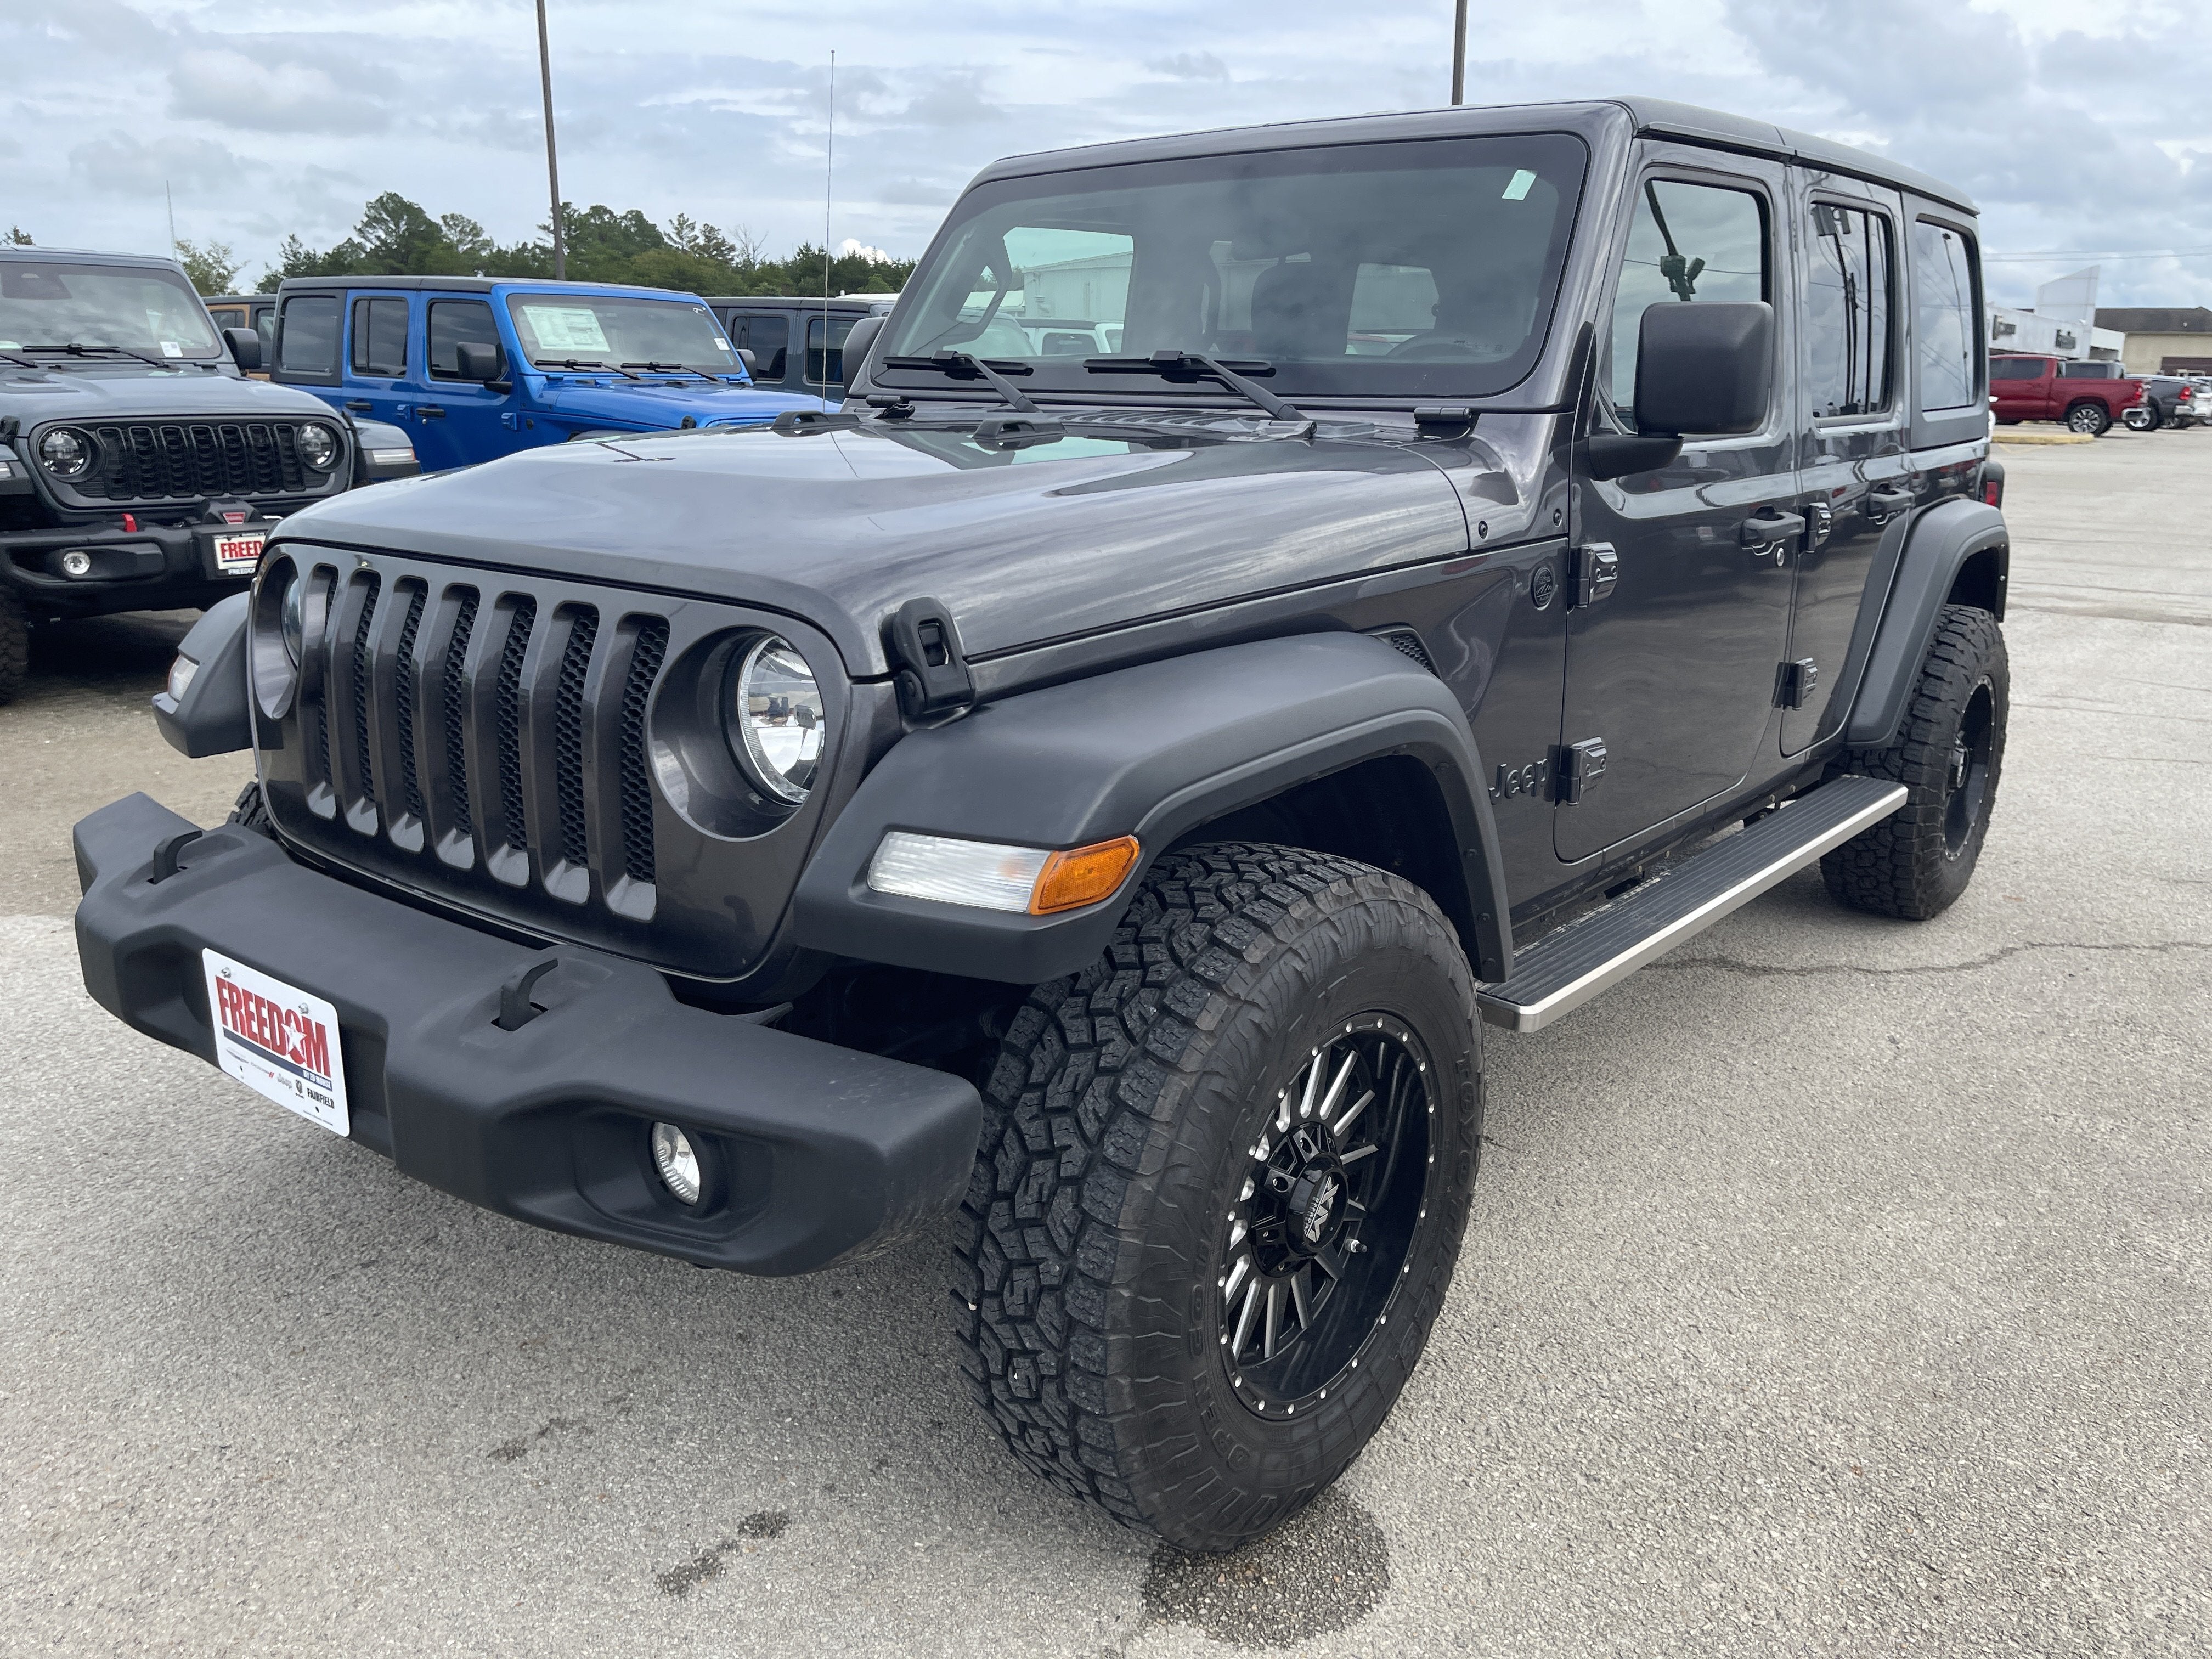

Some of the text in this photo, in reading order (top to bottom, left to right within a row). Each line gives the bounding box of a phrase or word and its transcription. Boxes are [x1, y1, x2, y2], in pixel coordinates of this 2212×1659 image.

[1488, 759, 1548, 805] Jeep
[216, 976, 330, 1077] FREEDOM
[277, 1074, 292, 1091] Jeep
[307, 1088, 335, 1109] FAIRFIELD
[1456, 1049, 1475, 1185] TOYO
